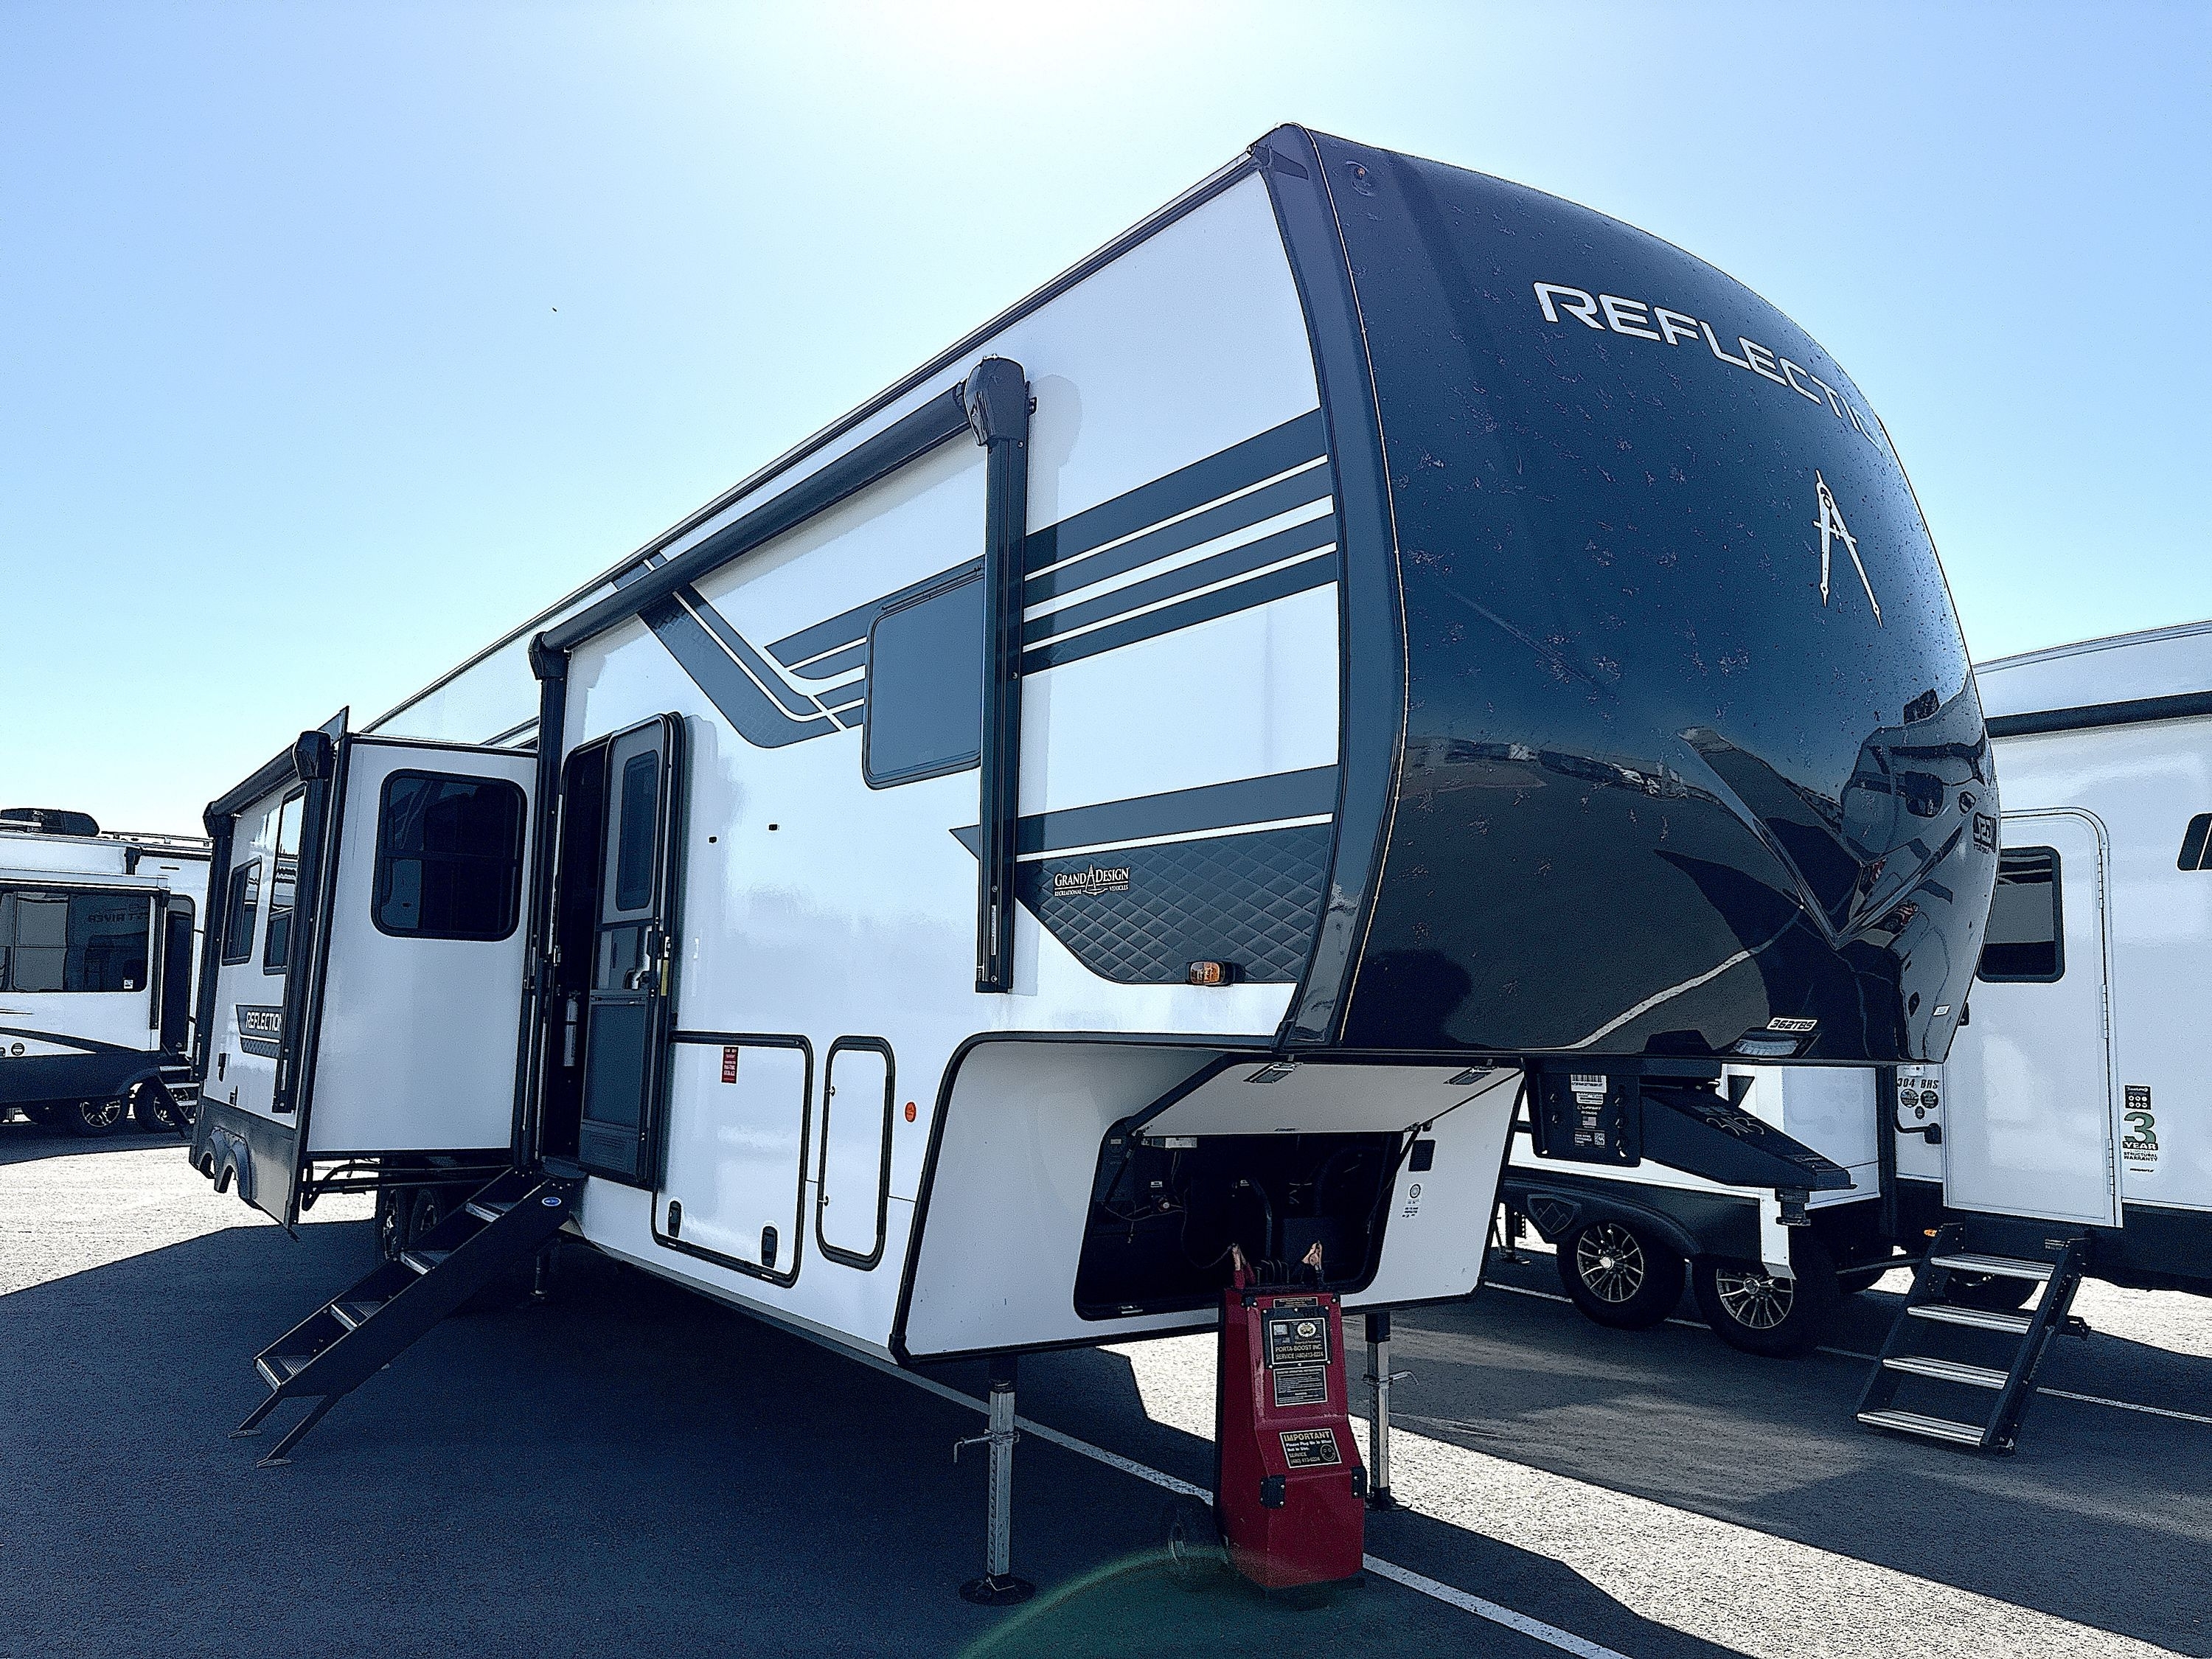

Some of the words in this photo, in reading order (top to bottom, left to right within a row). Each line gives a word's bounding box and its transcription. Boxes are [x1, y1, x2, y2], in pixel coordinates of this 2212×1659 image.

[1534, 282, 1888, 459] REFLECTIO
[1054, 873, 1086, 886] GRAND
[1096, 868, 1129, 883] DESIGN
[1921, 1079, 1939, 1089] BHS
[2124, 1111, 2156, 1143] 3
[1284, 1431, 1329, 1441] IMPORTANT
